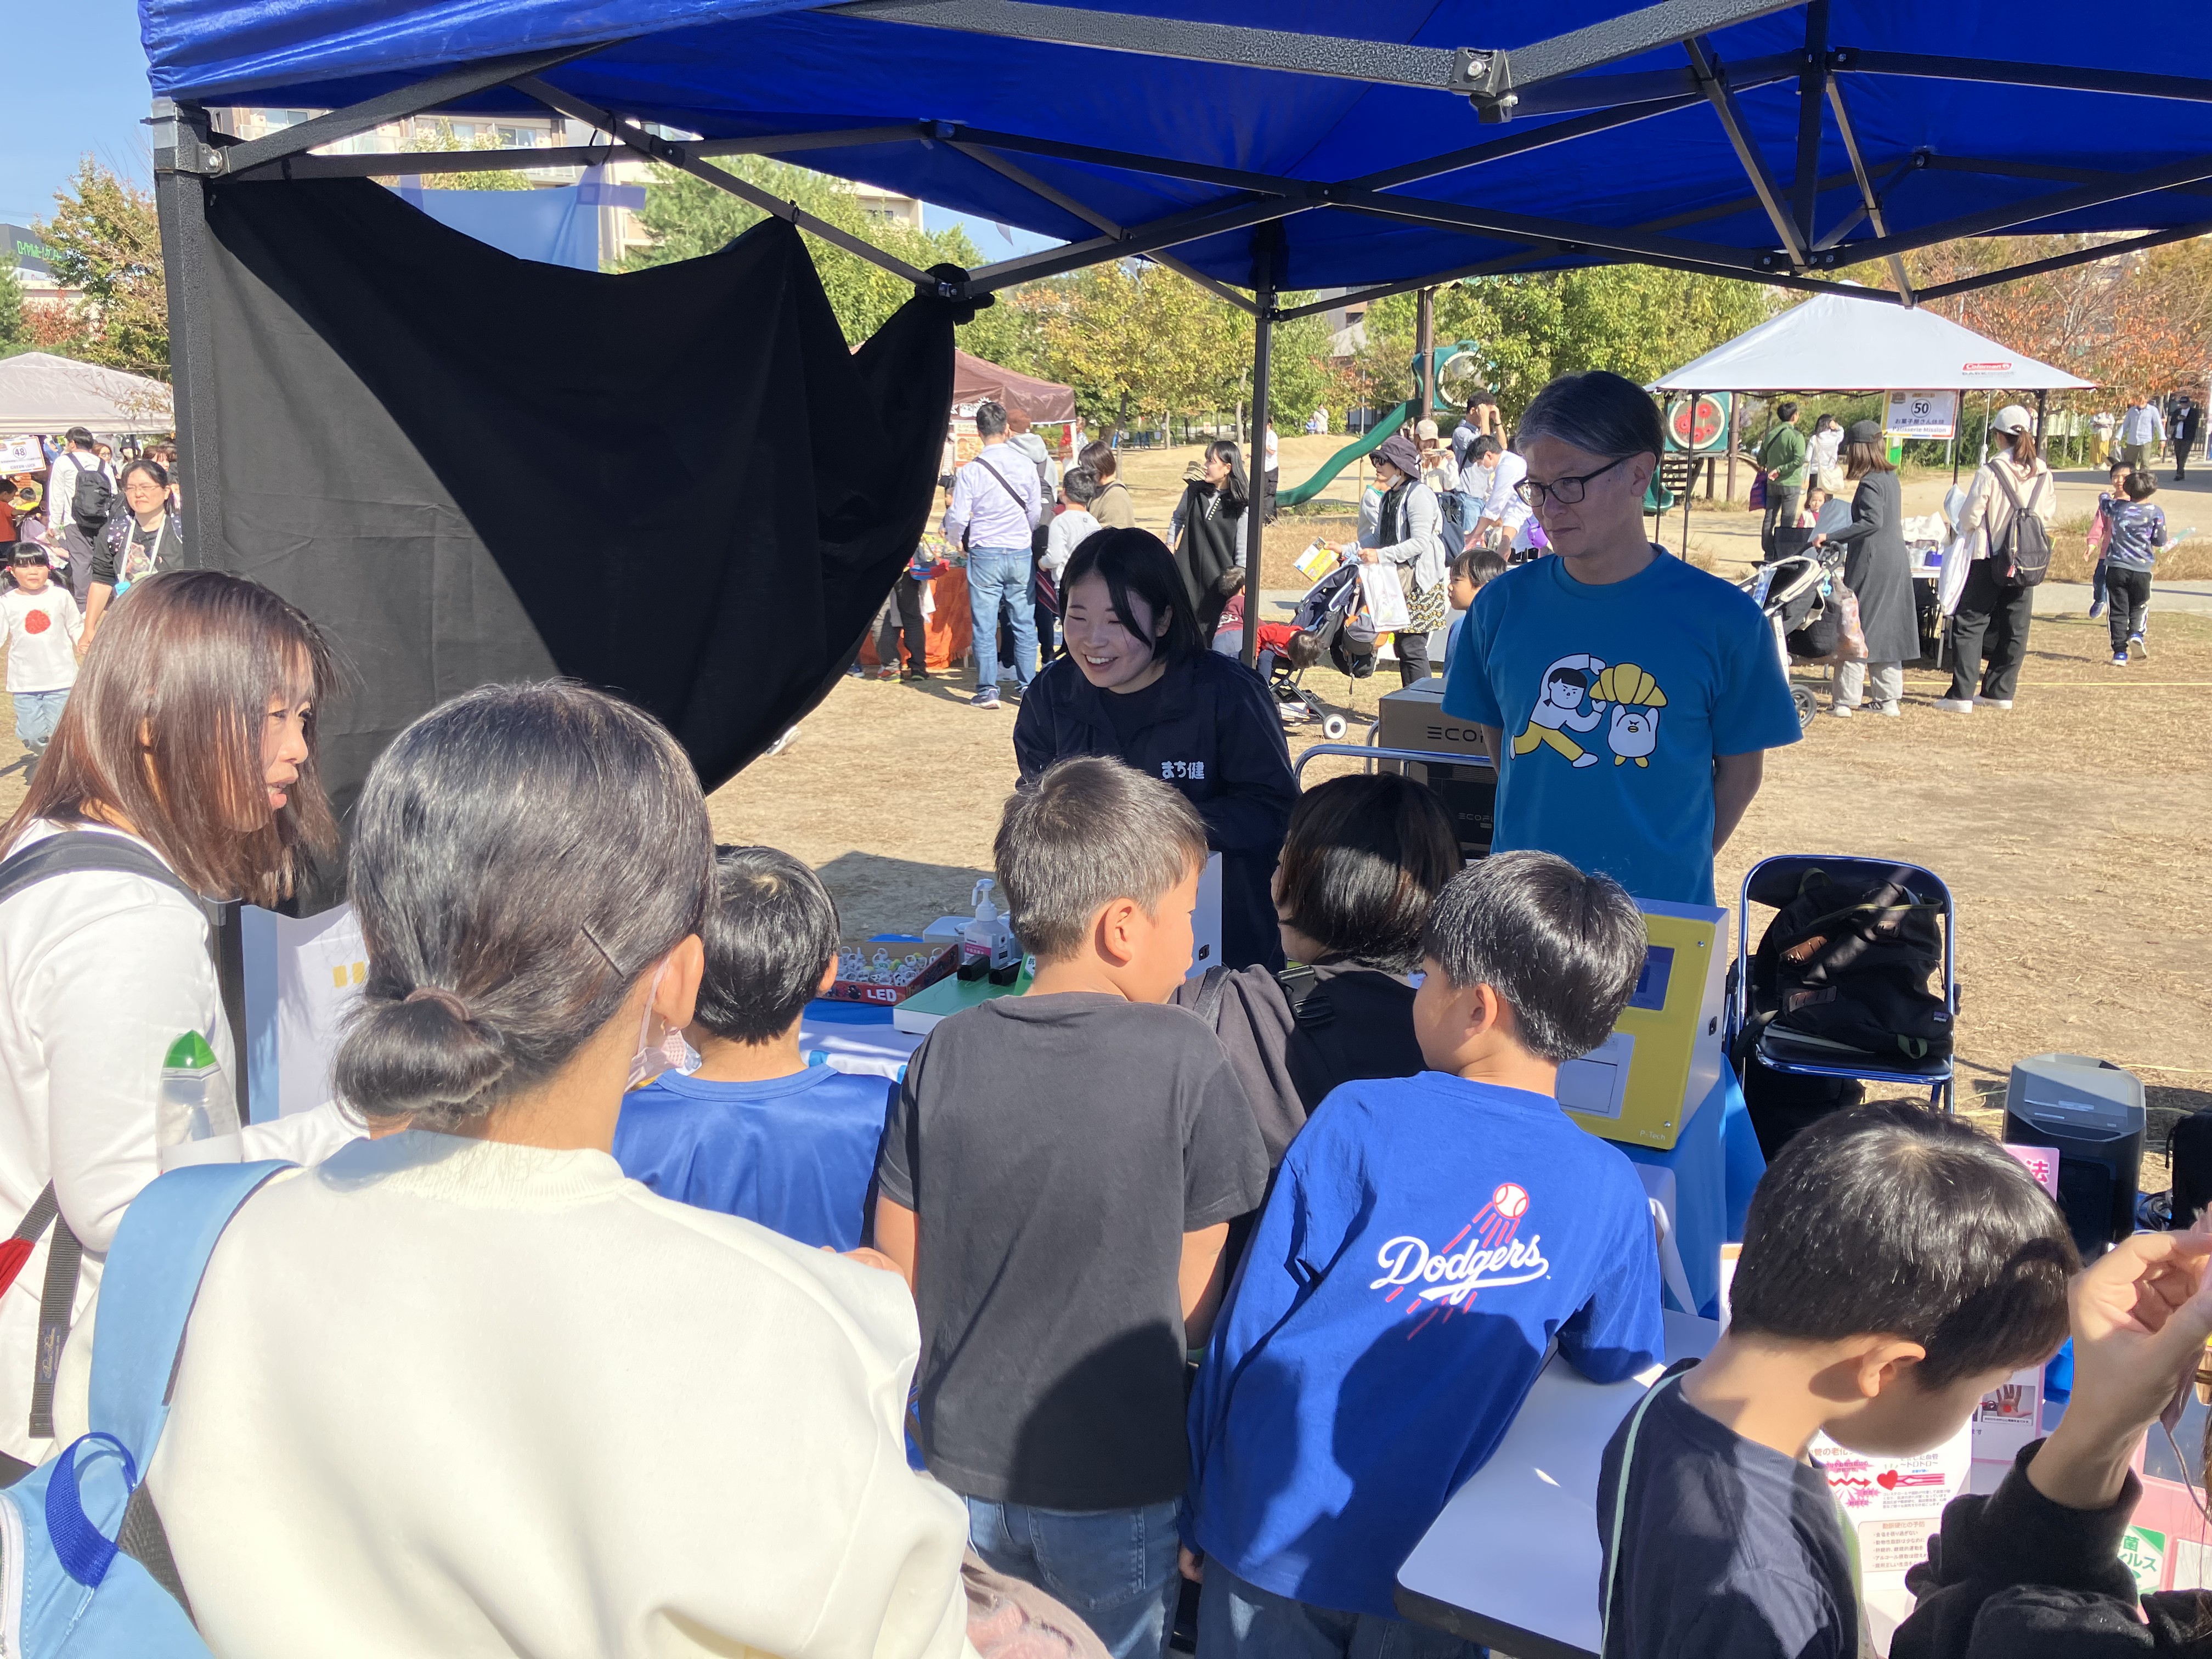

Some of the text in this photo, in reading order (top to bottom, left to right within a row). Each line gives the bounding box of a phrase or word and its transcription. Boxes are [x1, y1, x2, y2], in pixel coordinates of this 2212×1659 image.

[1914, 403, 1929, 414] 50
[15, 448, 25, 456] 48
[1161, 760, 1204, 779] まち健
[867, 989, 897, 1002] LED
[1640, 1130, 1666, 1141] P-Tech
[2026, 1160, 2049, 1182] 法
[1370, 1234, 1549, 1305] Dodgers
